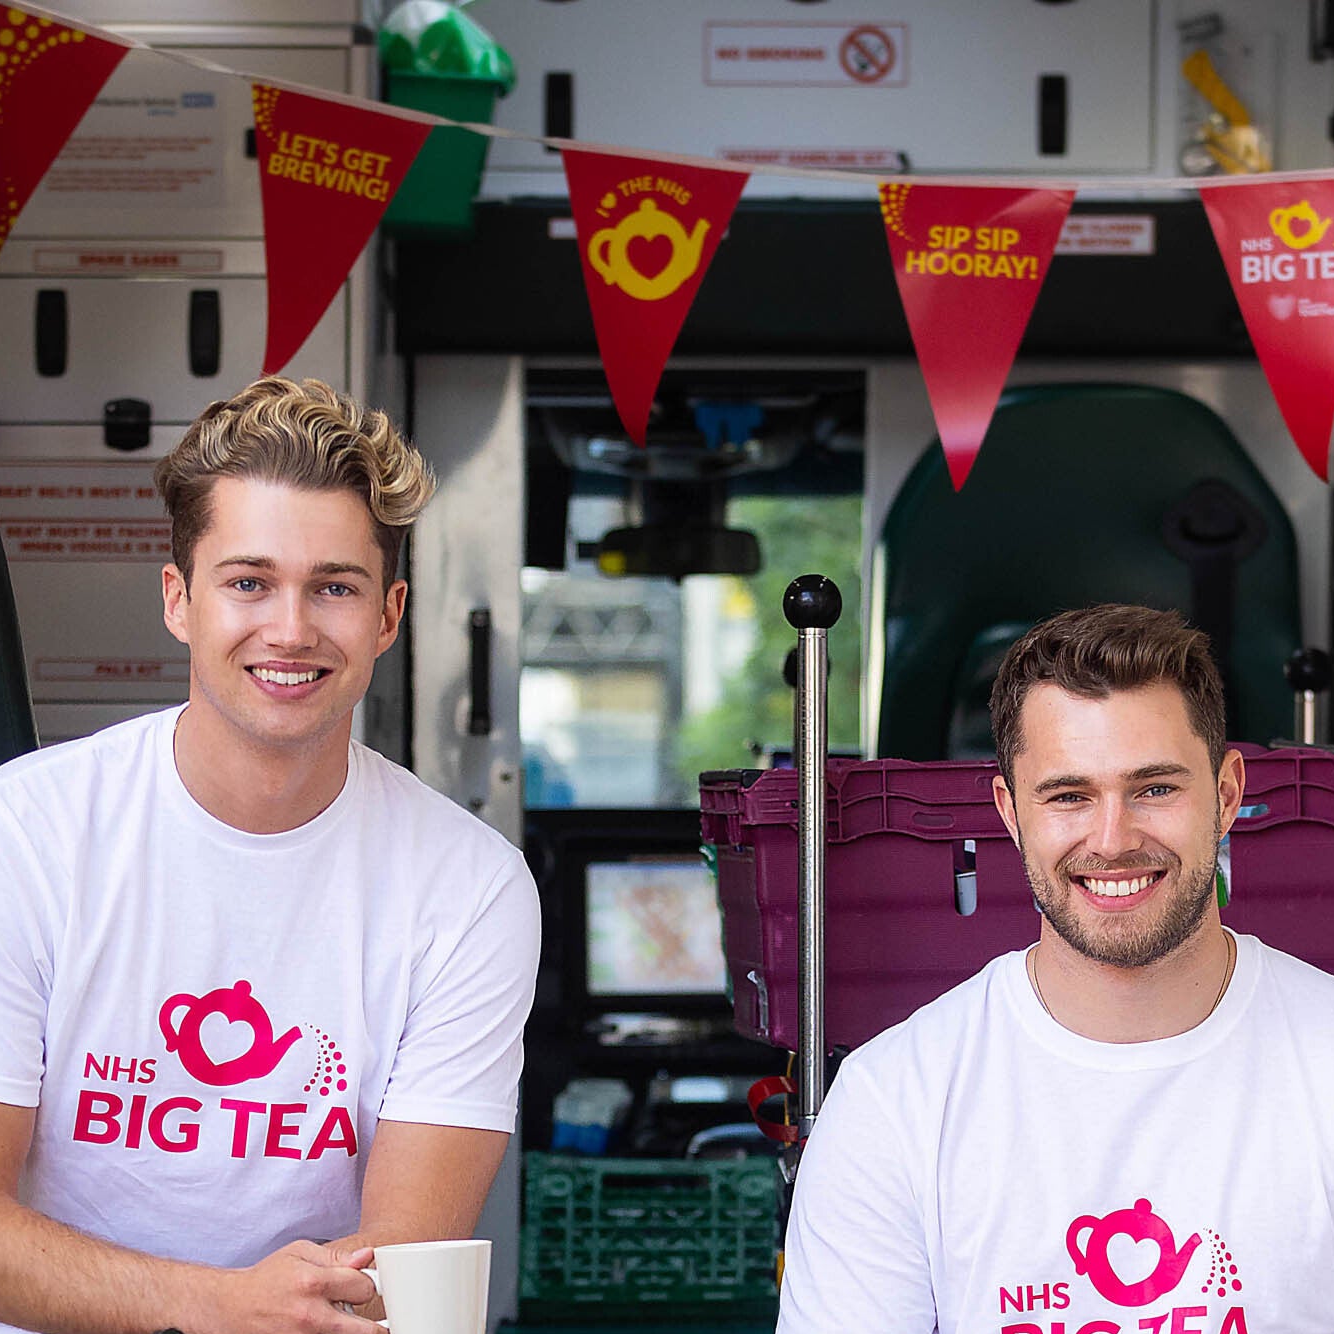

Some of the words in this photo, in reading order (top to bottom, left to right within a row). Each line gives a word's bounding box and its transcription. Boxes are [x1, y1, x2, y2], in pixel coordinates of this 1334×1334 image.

[716, 46, 741, 61] NO
[746, 46, 825, 61] SMOKING
[277, 131, 339, 165] LET'S
[342, 148, 391, 177] GET
[268, 152, 390, 203] BREWING!
[617, 175, 653, 197] THE
[655, 177, 693, 206] NHS
[927, 225, 971, 249] SIP
[975, 226, 1020, 251] SIP
[1241, 237, 1274, 252] NHS
[905, 251, 1039, 280] HOORAY!
[1241, 253, 1296, 284] BIG
[83, 1052, 157, 1084] NHS
[72, 1089, 203, 1154] BIG
[220, 1098, 358, 1161] TEA
[999, 1282, 1071, 1314] NHS
